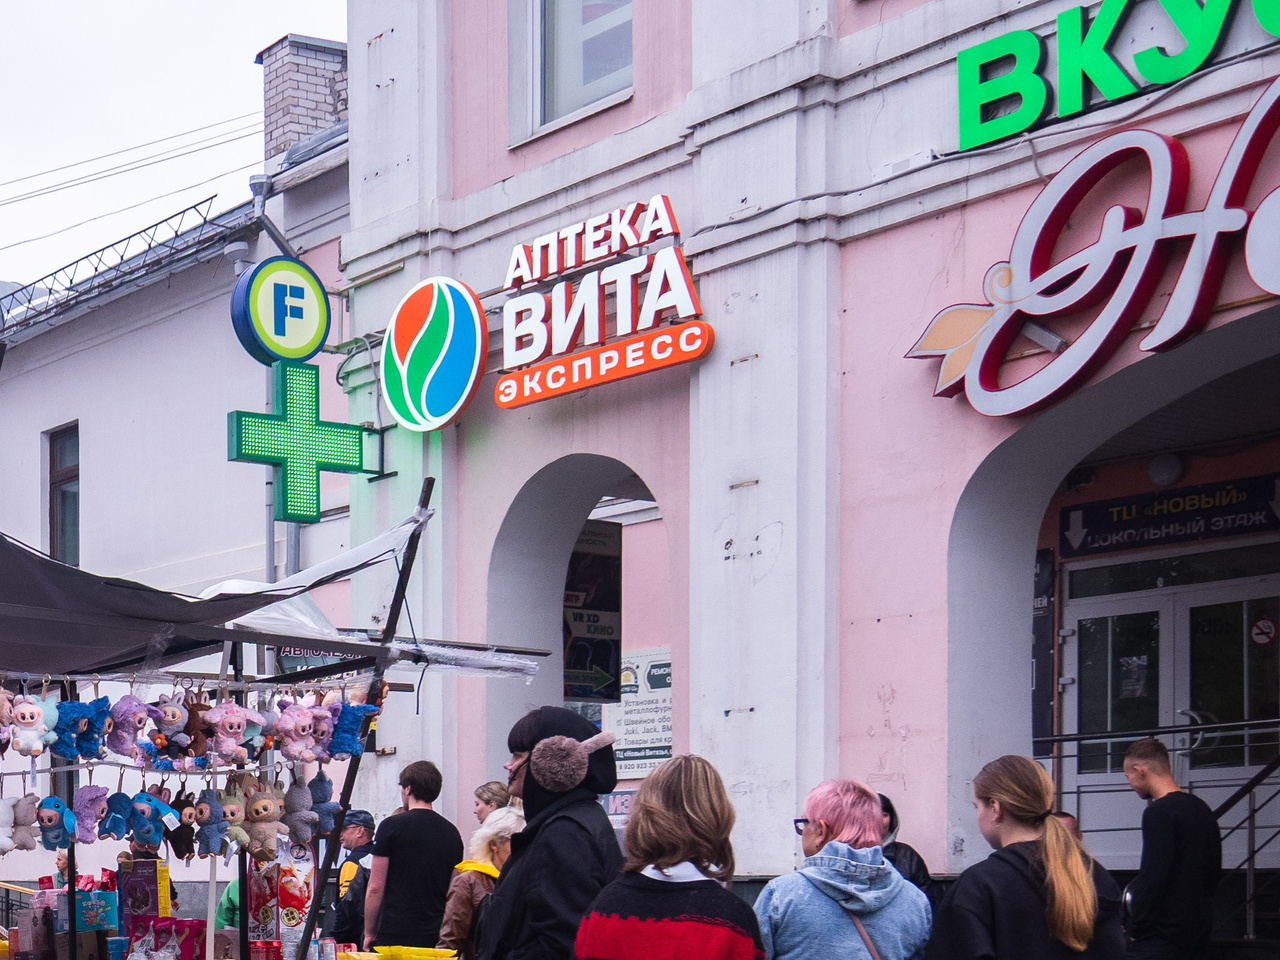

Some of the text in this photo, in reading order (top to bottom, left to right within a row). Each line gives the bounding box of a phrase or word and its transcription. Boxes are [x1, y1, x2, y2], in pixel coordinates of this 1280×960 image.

[957, 0, 1280, 151] ВКУ
[504, 194, 680, 290] АПТЕКА
[273, 282, 305, 337] F
[502, 246, 703, 369] ВИТА
[498, 325, 703, 402] ЭКСПРЕСС
[1087, 510, 1269, 548] ЦОКОЛЬНЫЙ ЭТАЖ
[1109, 485, 1248, 522] ТЦ «НОВЫЙ»
[624, 698, 659, 707] Установка
